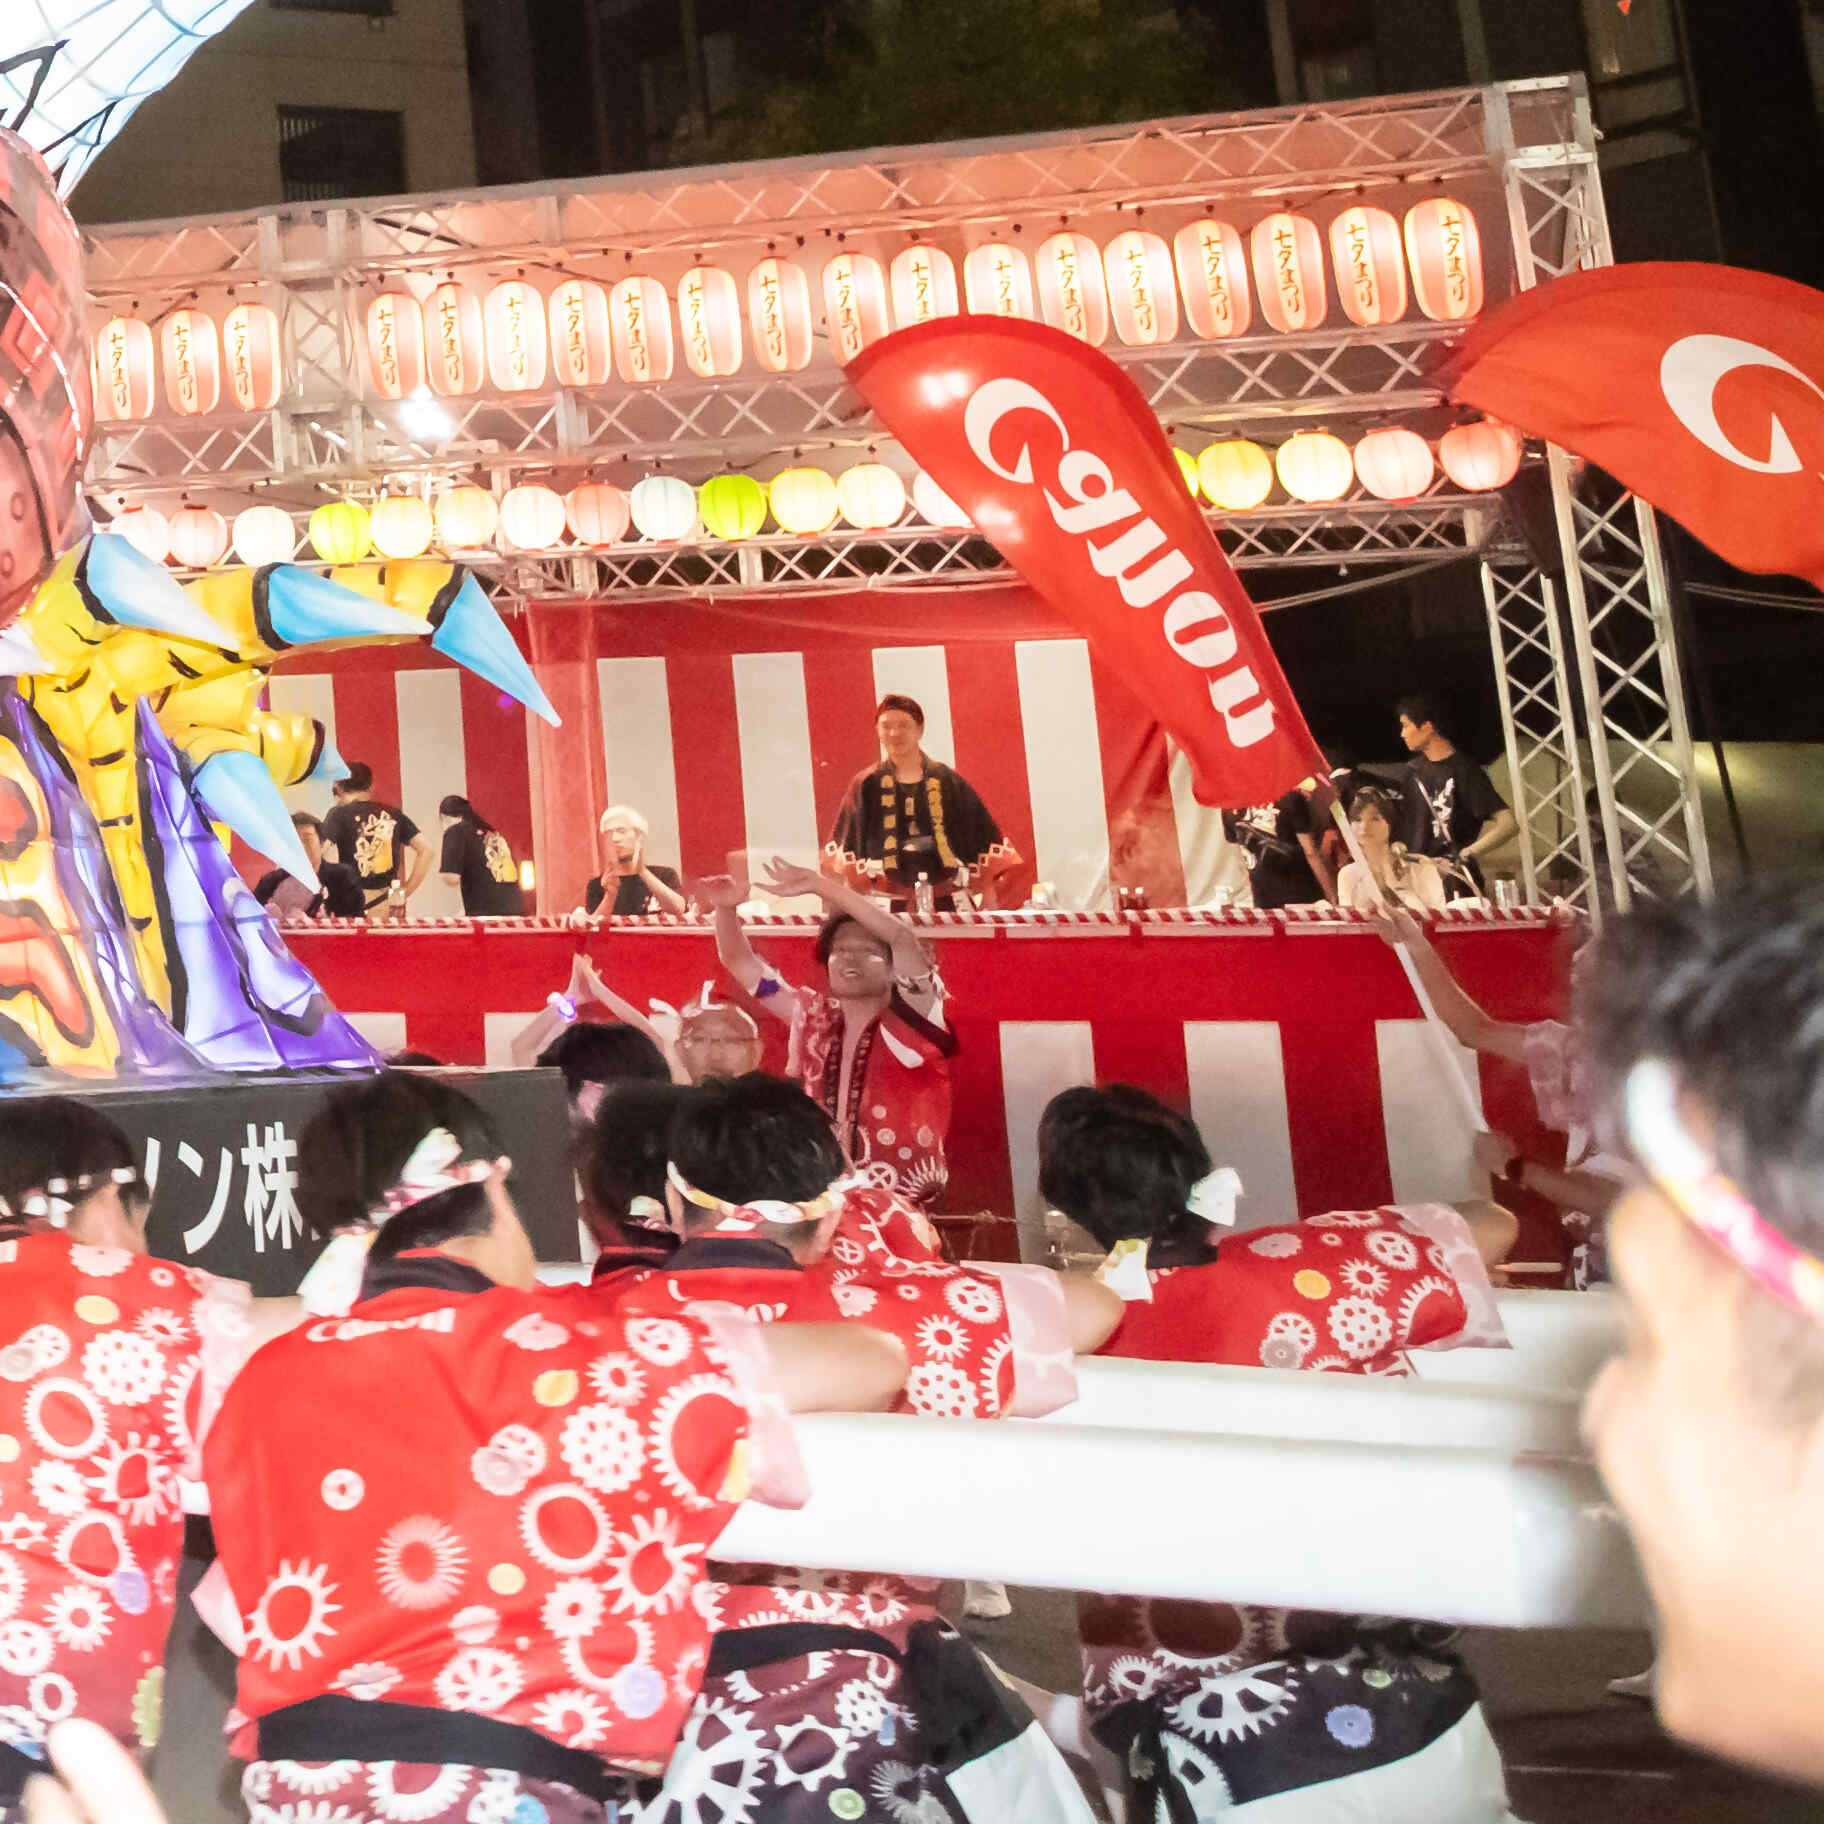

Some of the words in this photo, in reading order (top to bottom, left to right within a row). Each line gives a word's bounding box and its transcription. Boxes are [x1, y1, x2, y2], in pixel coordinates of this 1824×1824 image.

[912, 261, 934, 322] 七夕ま
[995, 260, 1015, 314] 七夕ま
